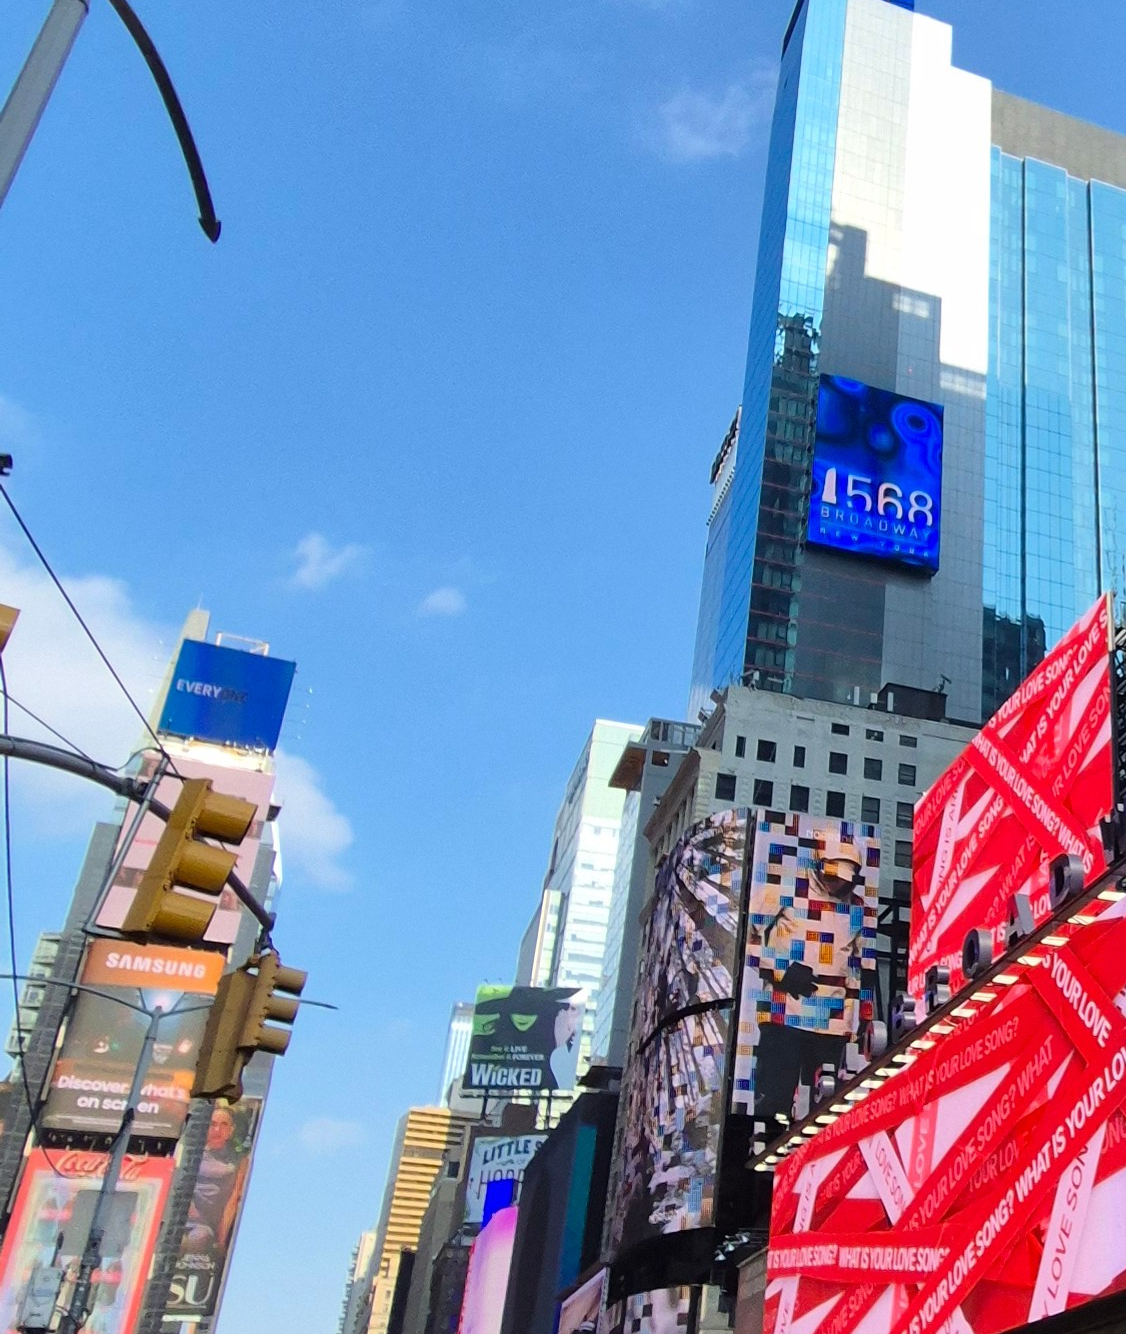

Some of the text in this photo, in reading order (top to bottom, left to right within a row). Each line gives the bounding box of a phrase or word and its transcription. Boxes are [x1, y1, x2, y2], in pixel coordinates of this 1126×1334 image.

[821, 467, 933, 527] 1568
[821, 506, 931, 541] BROADWAY
[819, 527, 859, 542] NEW
[1020, 674, 1045, 705] LOVE
[1045, 672, 1075, 719] YOUR
[1072, 626, 1102, 676] LOVE
[1062, 727, 1092, 779] LOVE
[995, 758, 1018, 791] YOUR
[1013, 775, 1036, 807] LOVE
[1033, 789, 1060, 834] SONG?
[1057, 821, 1085, 862] WHAT
[1081, 850, 1095, 874] IS
[935, 871, 959, 915] YOUR
[954, 834, 979, 880] LOVE
[105, 951, 207, 979] SAMSUNG
[1050, 951, 1112, 1049] YOUR LOVE
[934, 1054, 959, 1085] YOUR
[957, 1041, 984, 1072] LOVE
[983, 1015, 1020, 1056] SONG?
[77, 1094, 160, 1116] on scren
[919, 1176, 949, 1223] YOUR
[948, 1136, 978, 1186] LOVE
[976, 1085, 1017, 1152] SONG?
[1015, 1034, 1054, 1097] WHAT
[482, 1138, 532, 1165] LITTLE
[918, 1278, 950, 1329] YOUR
[948, 1240, 977, 1294] LOVE
[975, 1188, 1015, 1257] SONG?
[1014, 1146, 1053, 1205] WHAT
[1052, 1125, 1067, 1160] IS
[1064, 1076, 1105, 1140] YOUR
[779, 1248, 798, 1269] YOUR
[812, 1244, 839, 1267] SONG?
[838, 1247, 862, 1269] WHAT
[861, 1247, 870, 1269] IS
[868, 1247, 894, 1271] YOUR
[893, 1247, 917, 1272] LOVE
[1046, 1213, 1074, 1300] LOVE
